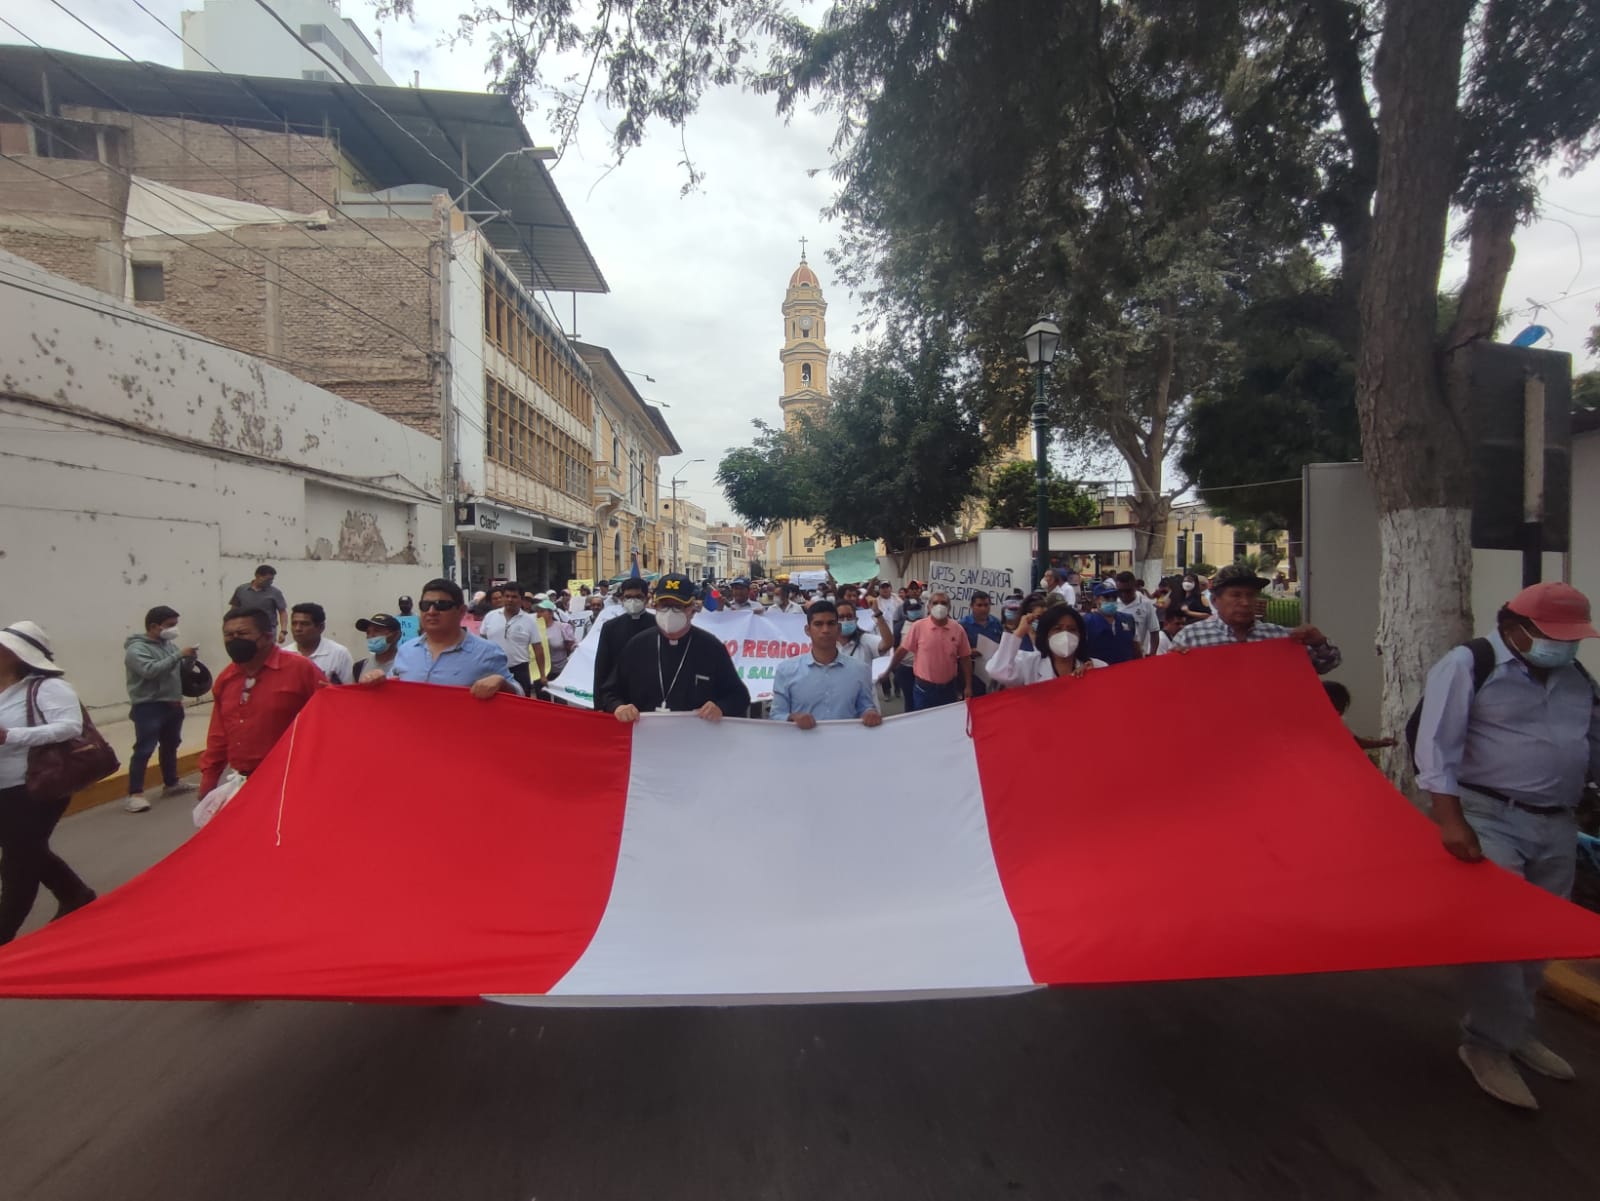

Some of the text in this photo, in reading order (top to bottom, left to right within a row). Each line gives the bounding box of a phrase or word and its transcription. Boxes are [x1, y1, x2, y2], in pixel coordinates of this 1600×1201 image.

[480, 513, 499, 530] Claro
[665, 580, 680, 590] M
[959, 568, 979, 585] SAN
[980, 569, 1012, 588] BORJA
